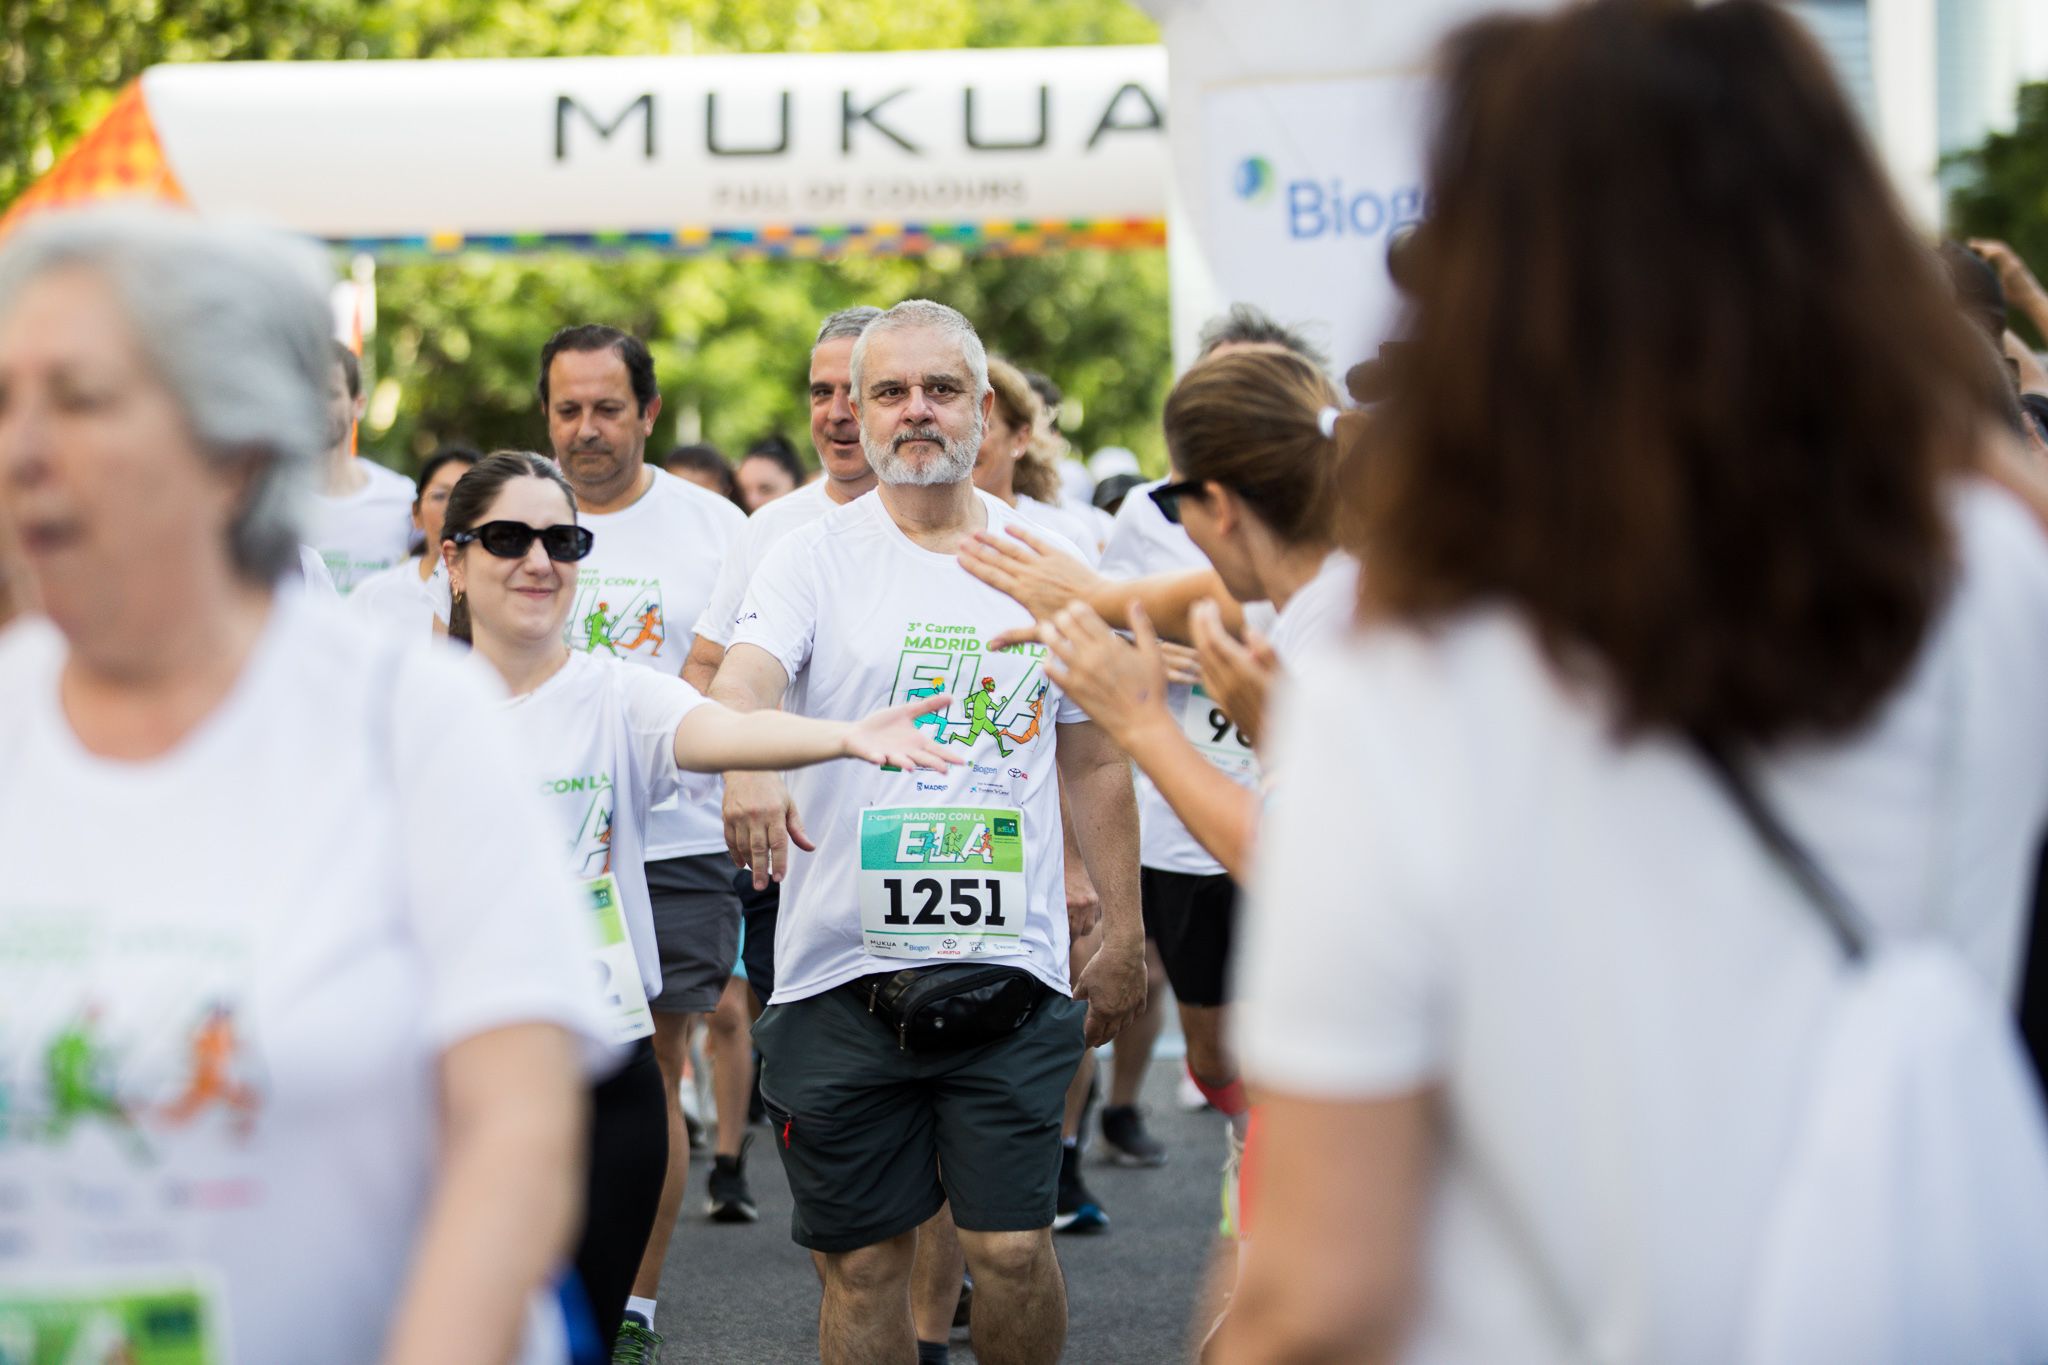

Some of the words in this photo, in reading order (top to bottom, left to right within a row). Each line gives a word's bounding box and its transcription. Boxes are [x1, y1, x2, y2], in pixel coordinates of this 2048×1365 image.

[554, 83, 1164, 160] MUKUA
[714, 180, 789, 209] FULL
[804, 180, 847, 208] OF
[861, 176, 1027, 207] COLOURS
[604, 577, 638, 587] CON
[925, 623, 976, 635] Carrera
[904, 635, 981, 651] MADRID
[973, 764, 998, 775] Biogen
[903, 812, 945, 821] MADRID
[948, 813, 971, 821] CON
[973, 813, 985, 821] LA
[896, 822, 994, 864] ELA
[883, 877, 1006, 927] 1251
